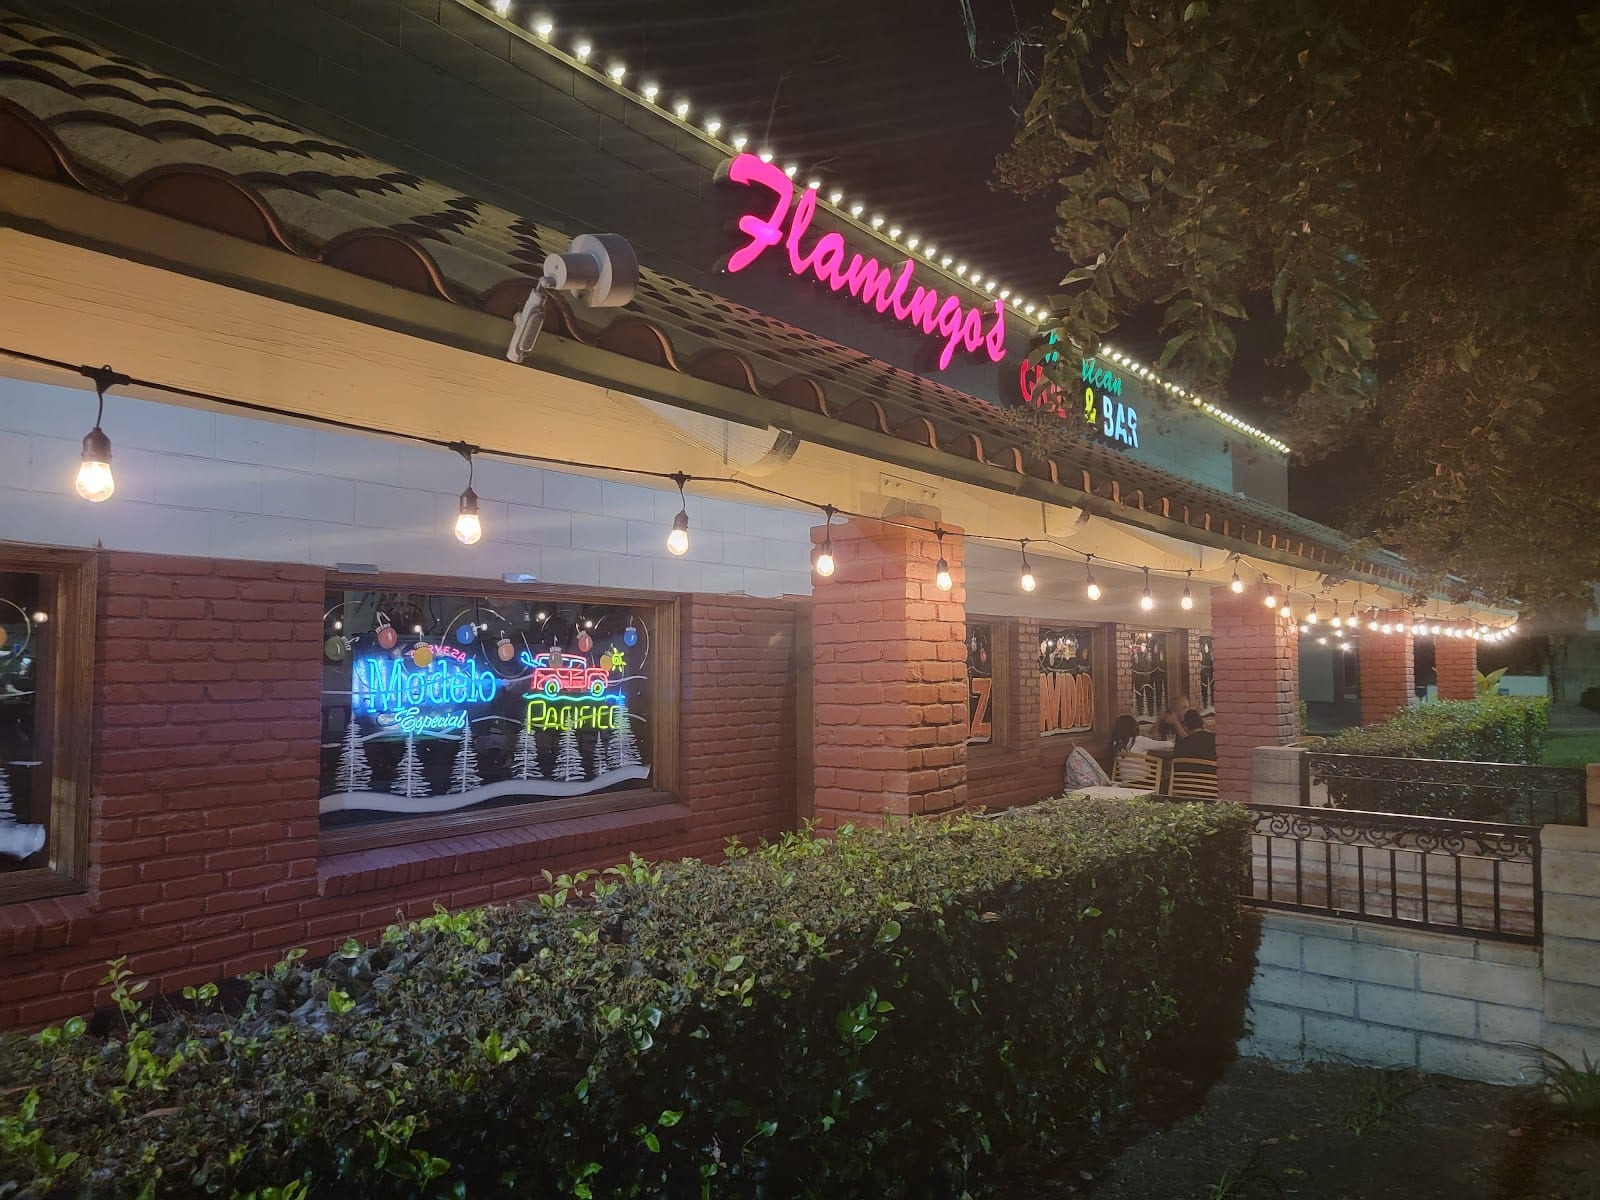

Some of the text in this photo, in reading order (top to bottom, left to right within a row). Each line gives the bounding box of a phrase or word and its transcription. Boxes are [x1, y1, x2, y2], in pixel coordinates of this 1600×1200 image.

[727, 152, 1007, 371] Flamingo's
[1102, 395, 1139, 448] BAR
[410, 644, 467, 664] CRVEZA
[367, 658, 497, 713] Modelo
[394, 706, 468, 735] Especial
